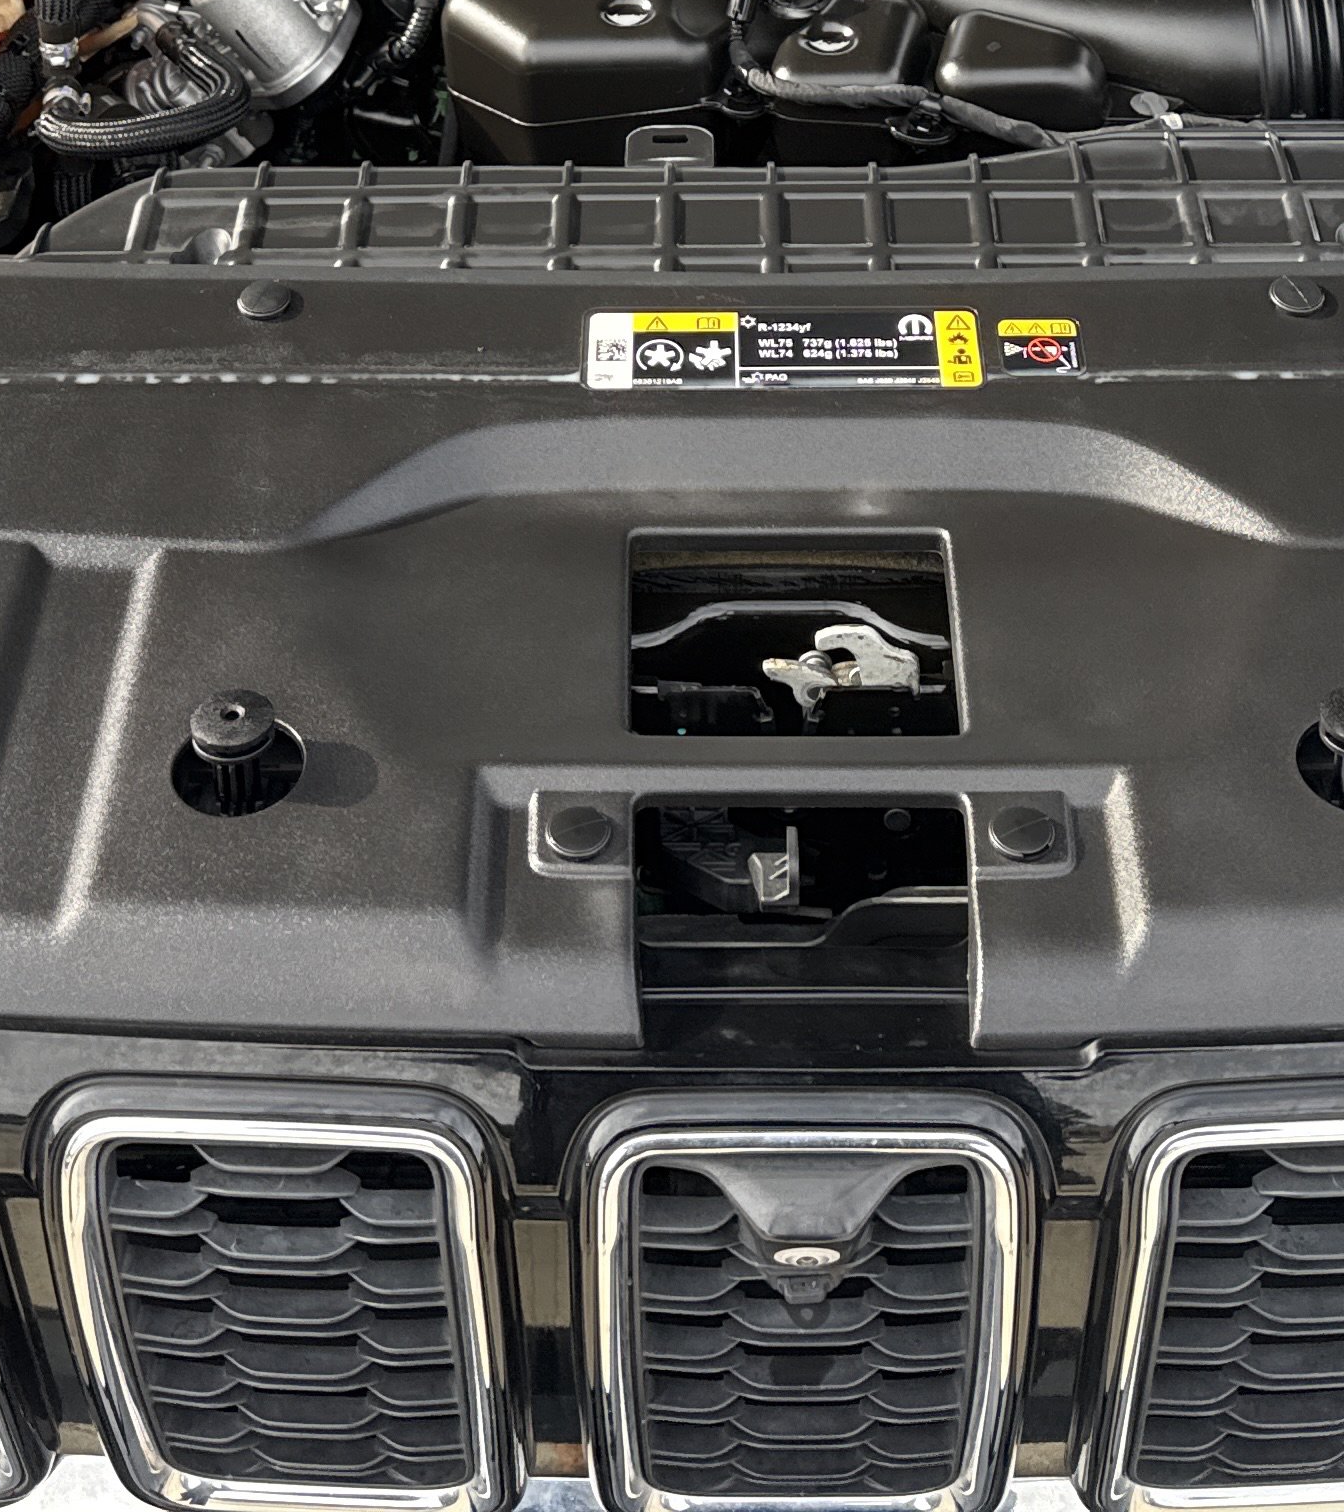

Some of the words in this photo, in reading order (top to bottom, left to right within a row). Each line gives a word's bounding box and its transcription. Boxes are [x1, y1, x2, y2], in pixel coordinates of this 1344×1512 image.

[757, 322, 812, 333] R-1234yf
[757, 338, 794, 348] WL75
[802, 338, 833, 349] 737g
[874, 338, 898, 349] lbs)
[757, 349, 794, 358] WL74
[802, 349, 833, 359] 624g
[874, 349, 899, 359] lbs)
